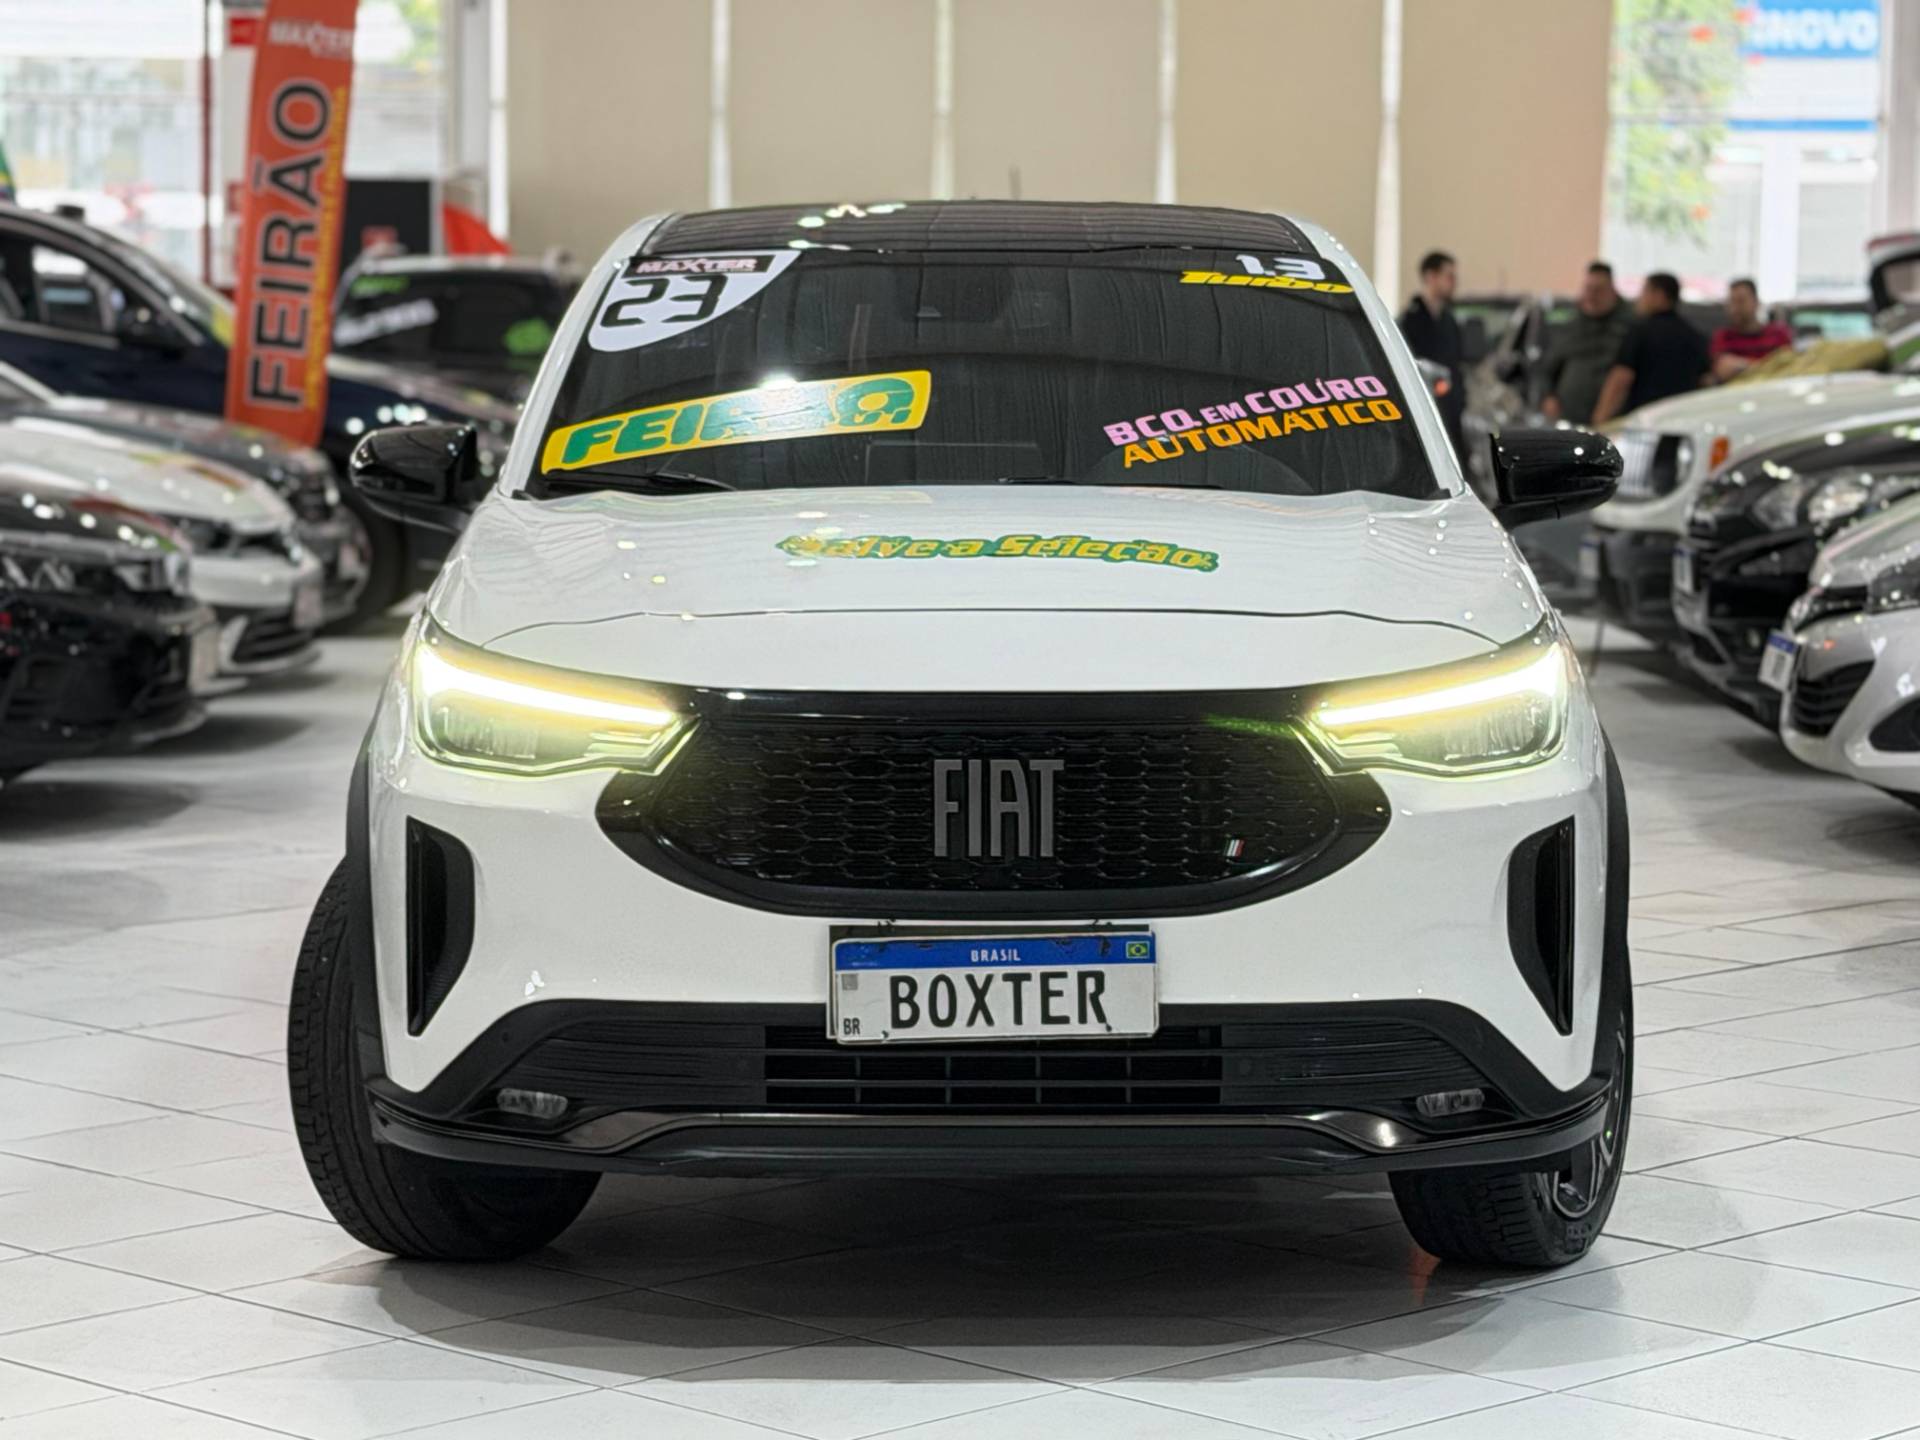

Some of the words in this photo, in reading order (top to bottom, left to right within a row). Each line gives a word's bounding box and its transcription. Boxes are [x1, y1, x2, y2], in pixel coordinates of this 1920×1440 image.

[248, 81, 333, 408] FEIRÃO
[636, 258, 757, 273] MAXTER
[1235, 254, 1326, 281] 1.3
[600, 274, 728, 328] 23
[562, 378, 914, 464] FEIRO
[1199, 402, 1248, 425] EM
[1245, 375, 1389, 414] COURO
[934, 759, 1065, 857] FIAT
[971, 949, 1021, 962] BRASIL
[843, 1017, 861, 1035] BR
[890, 971, 1107, 1029] BOXTER
